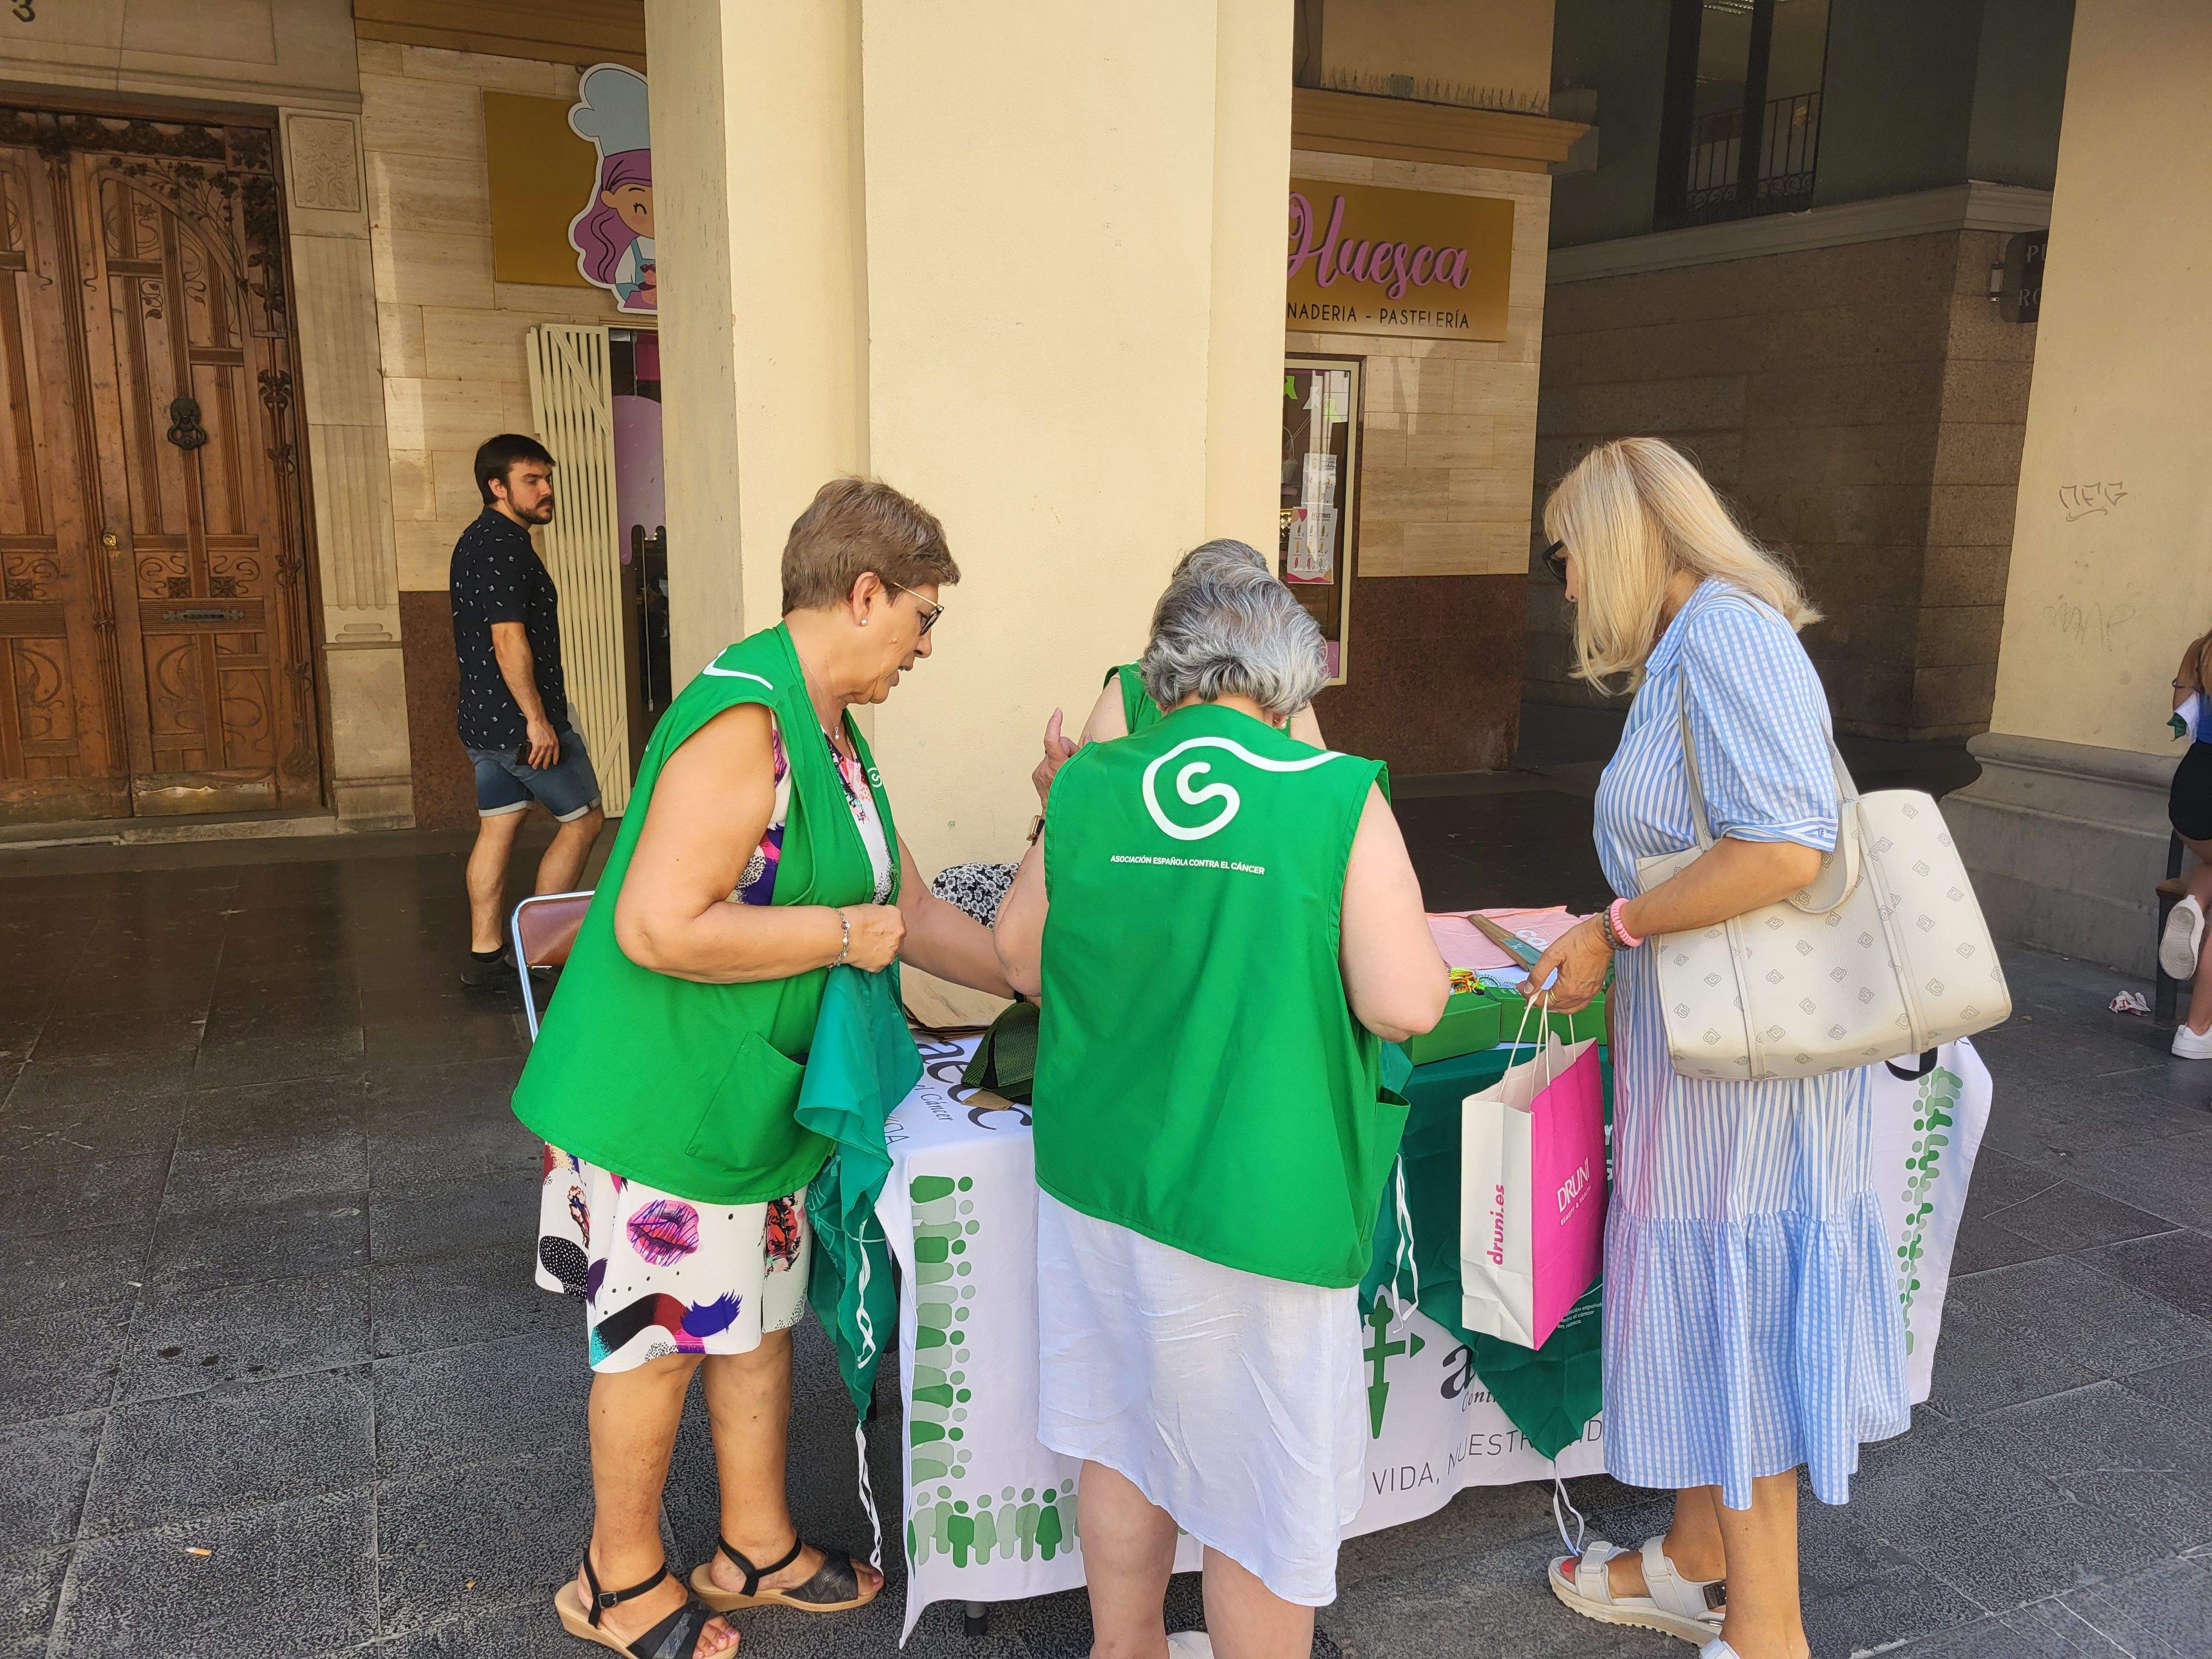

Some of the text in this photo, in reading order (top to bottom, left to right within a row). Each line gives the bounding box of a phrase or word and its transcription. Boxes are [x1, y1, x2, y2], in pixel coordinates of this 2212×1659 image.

[1287, 192, 1471, 300] Huesca
[1380, 307, 1469, 329] PASTELERÍA
[1110, 855, 1151, 864] ASOCIACIÓN
[1153, 857, 1188, 866] ESPAÑOLA
[1189, 859, 1219, 868] CONTRA
[1231, 862, 1265, 875] CÁNCER
[921, 1093, 954, 1121] Cáncer
[1557, 1156, 1590, 1213] DRUNI
[1486, 1184, 1504, 1265] druni.es
[1373, 1462, 1439, 1495] VIDA,
